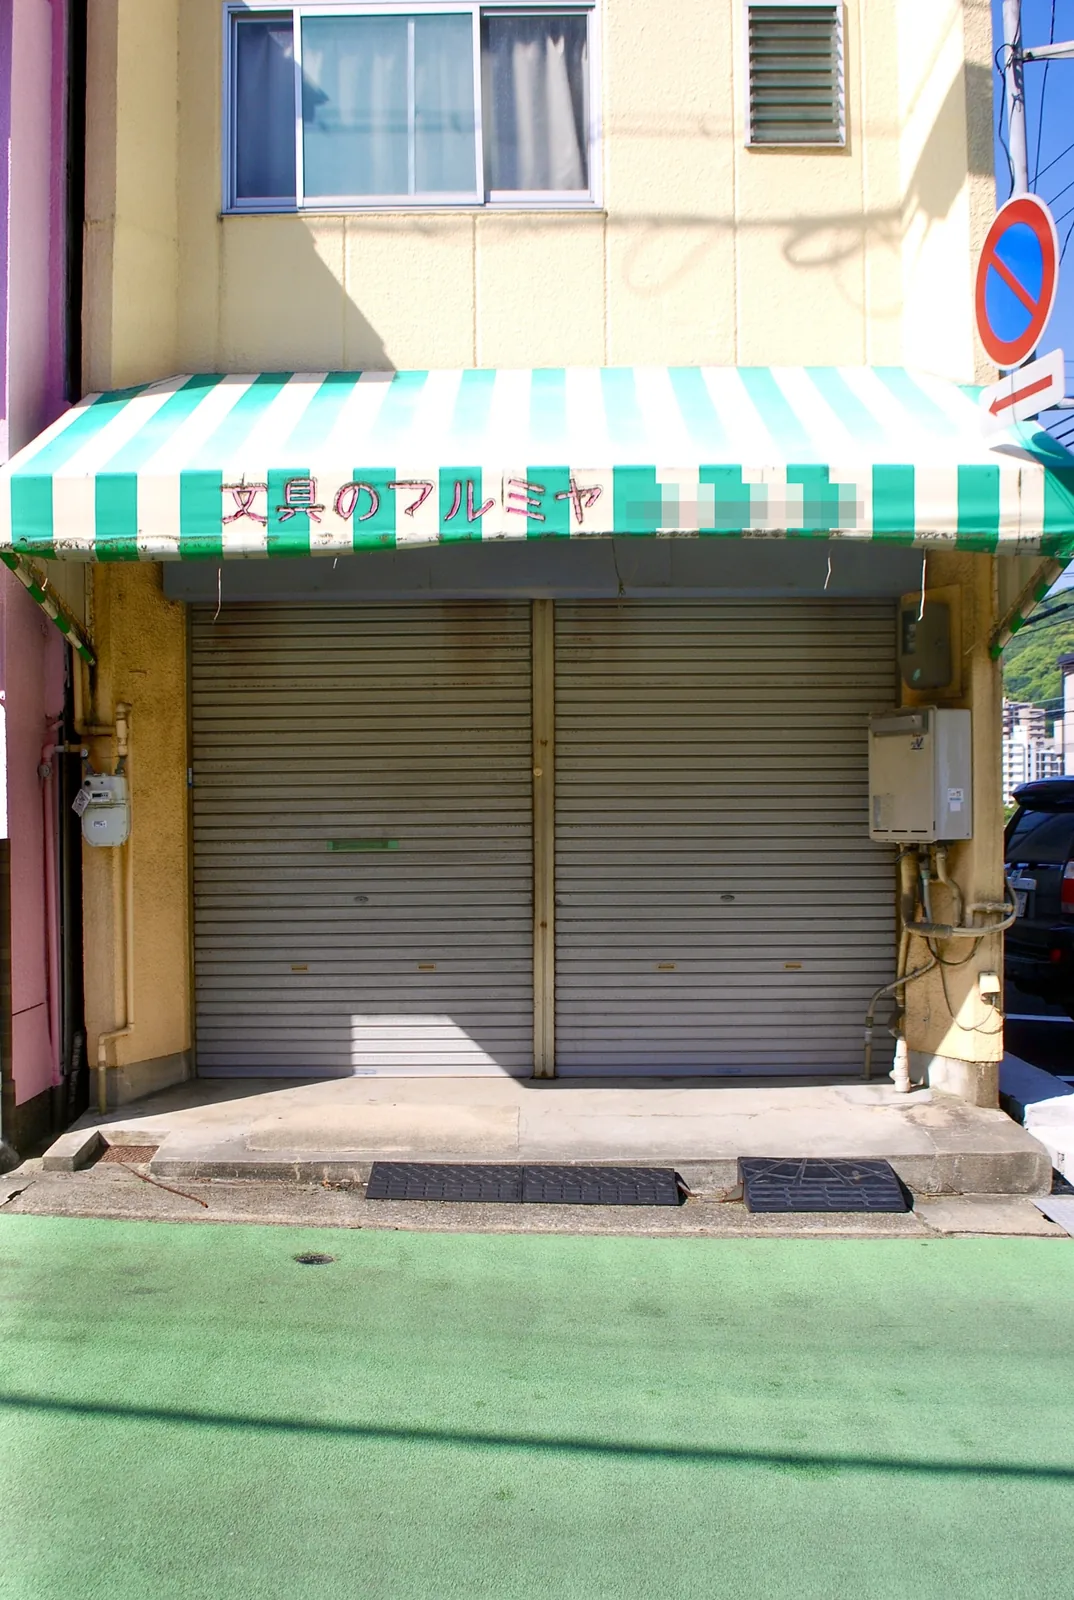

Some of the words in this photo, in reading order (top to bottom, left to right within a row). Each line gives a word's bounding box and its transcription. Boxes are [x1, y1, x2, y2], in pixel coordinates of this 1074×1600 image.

[220, 475, 603, 525] 文具のマルミヤ
